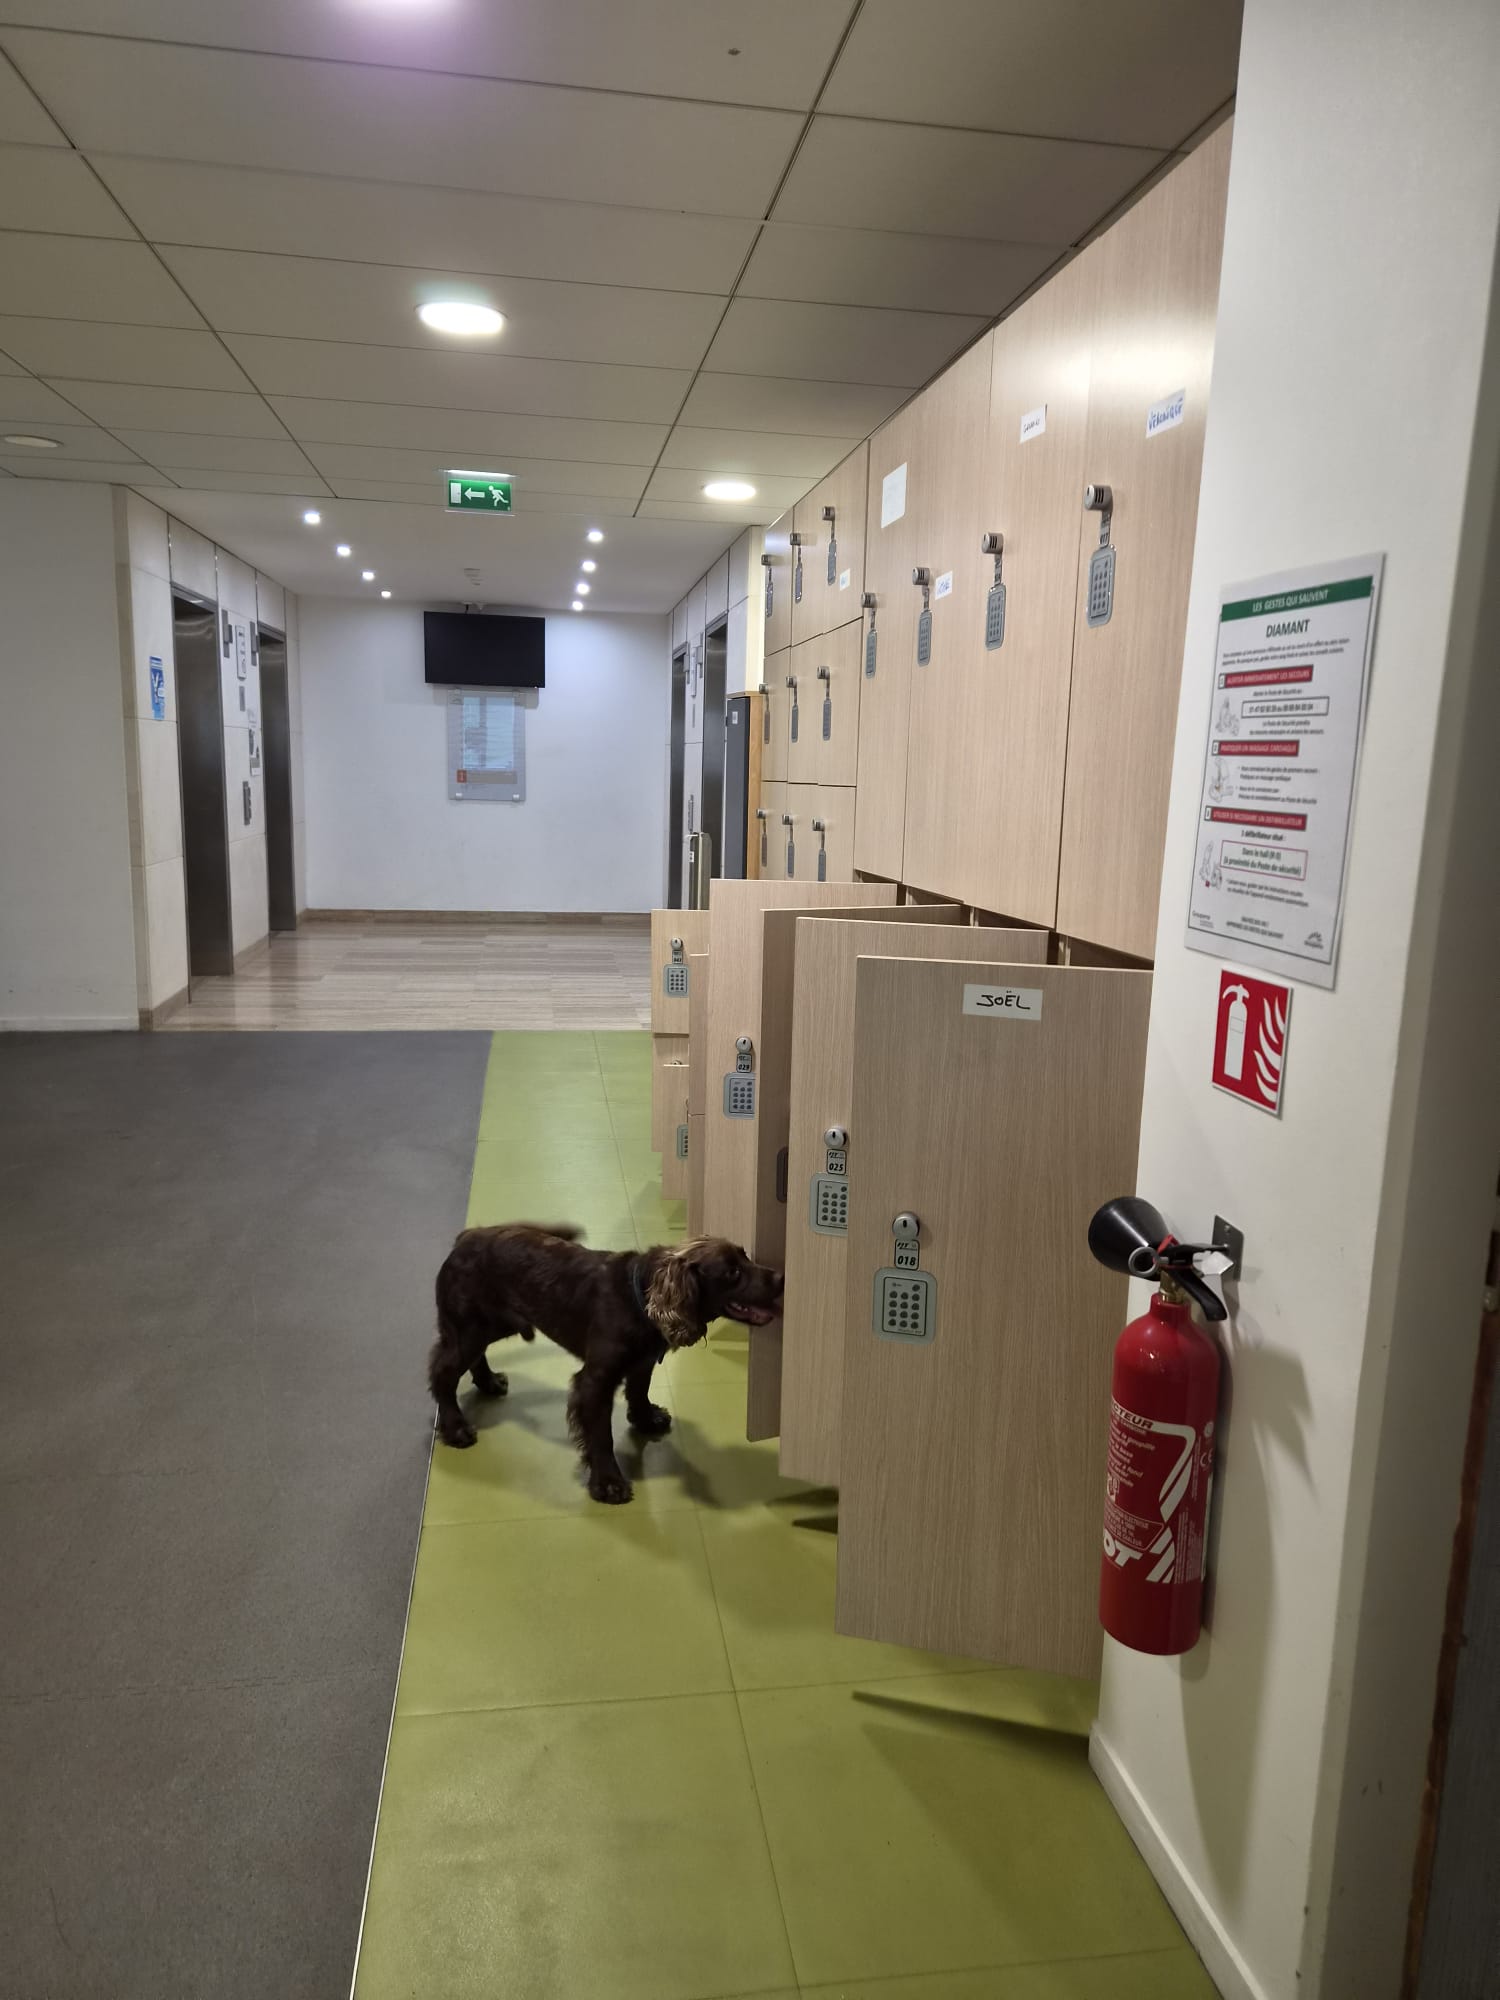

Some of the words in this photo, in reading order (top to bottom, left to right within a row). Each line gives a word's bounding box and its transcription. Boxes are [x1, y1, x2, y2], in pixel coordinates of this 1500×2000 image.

[1252, 602, 1263, 613] LES
[1264, 598, 1285, 610] GESTES
[1286, 595, 1297, 607] QUI
[1298, 589, 1329, 604] SAUVENT
[1265, 619, 1310, 638] DIAMANT
[976, 990, 1031, 1010] JOËL
[829, 1163, 843, 1171] 025
[897, 1255, 916, 1266] 018
[1112, 1401, 1154, 1430] CTEUR
